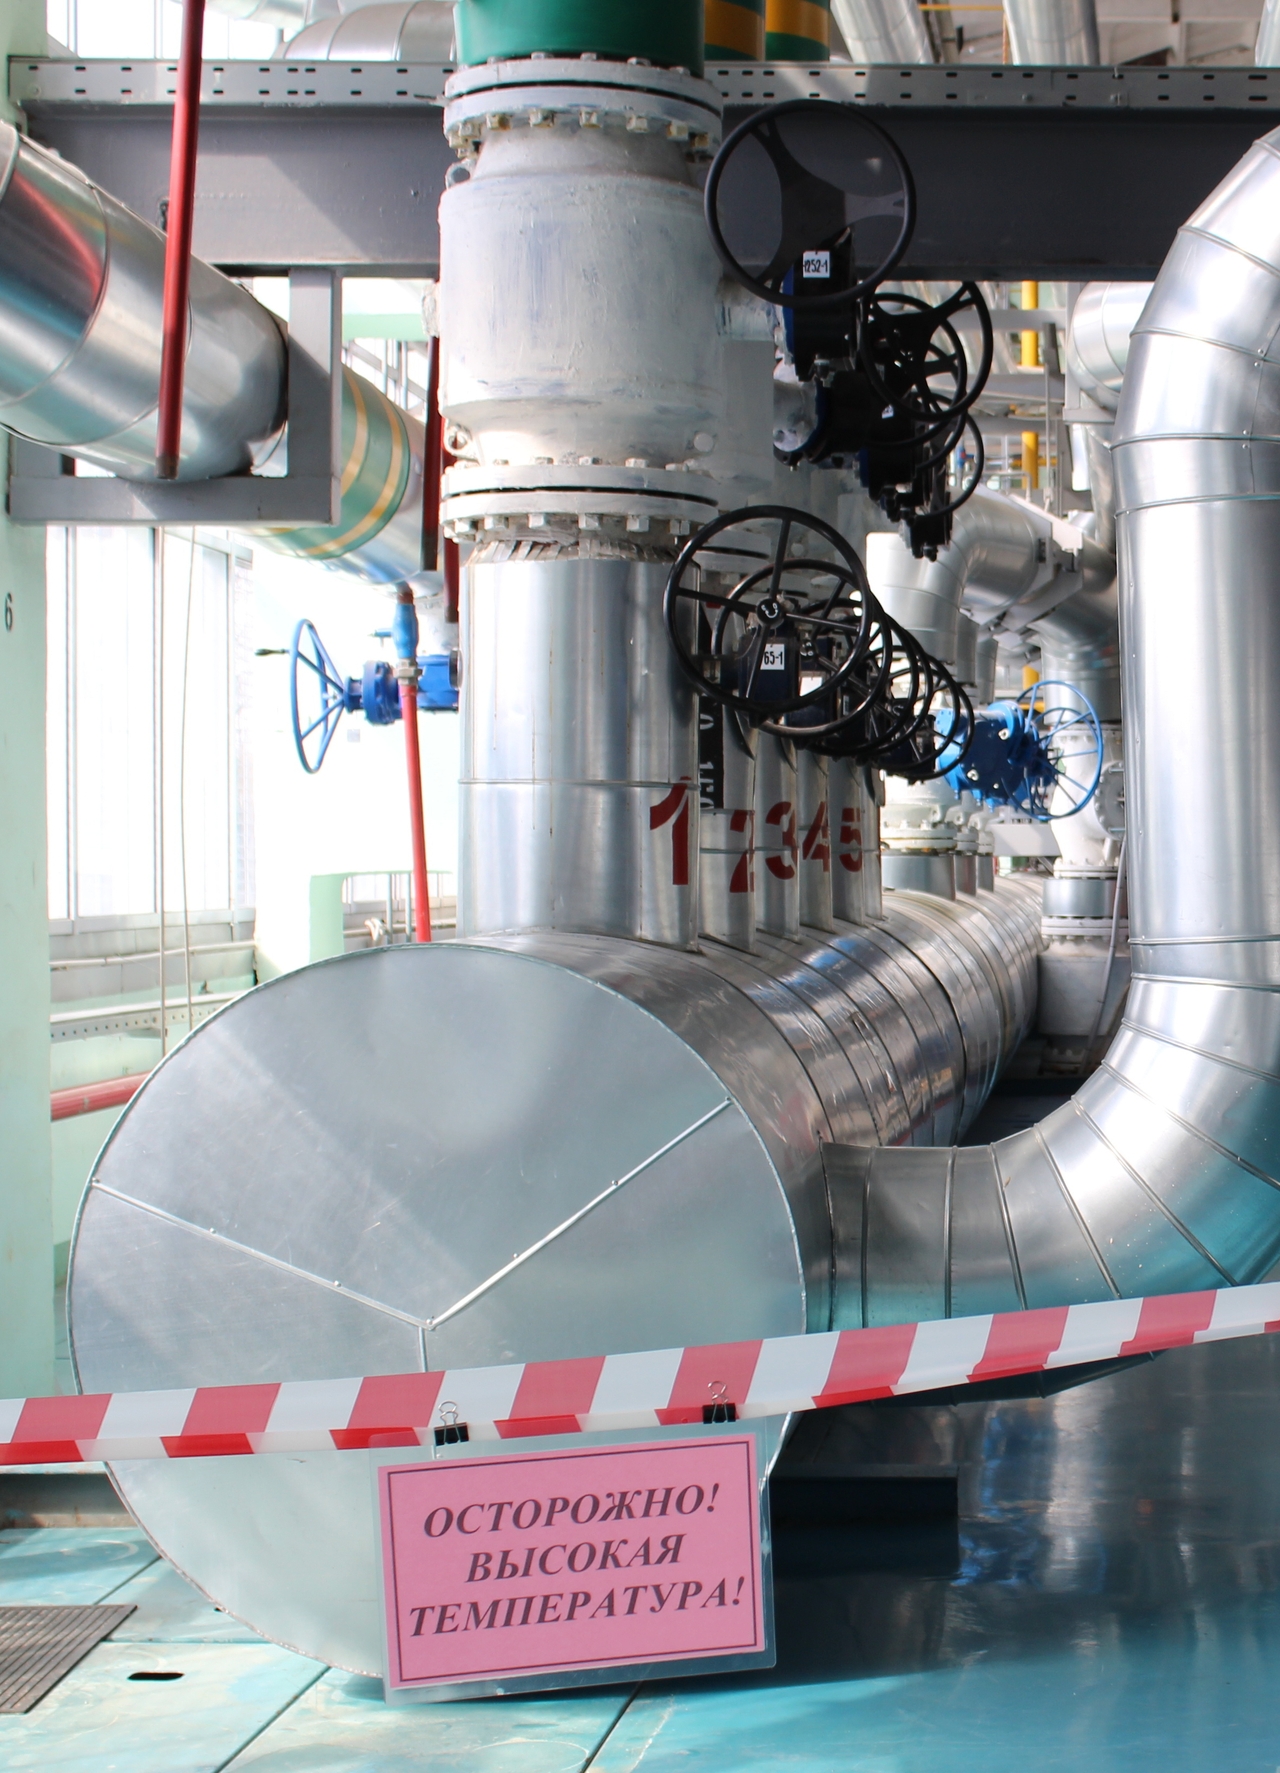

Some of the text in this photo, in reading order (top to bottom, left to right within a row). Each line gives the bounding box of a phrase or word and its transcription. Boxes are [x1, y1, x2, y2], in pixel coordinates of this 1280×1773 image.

[4, 592, 13, 632] 6
[650, 775, 689, 885] 1
[765, 801, 798, 880] 3
[802, 801, 831, 872] 4
[839, 807, 862, 872] 5
[423, 1482, 720, 1538] ОСТОРОЖНО!
[464, 1533, 687, 1584] ВЫСОКАЯ
[408, 1575, 746, 1638] ТЕМПЕРАТУРА!
